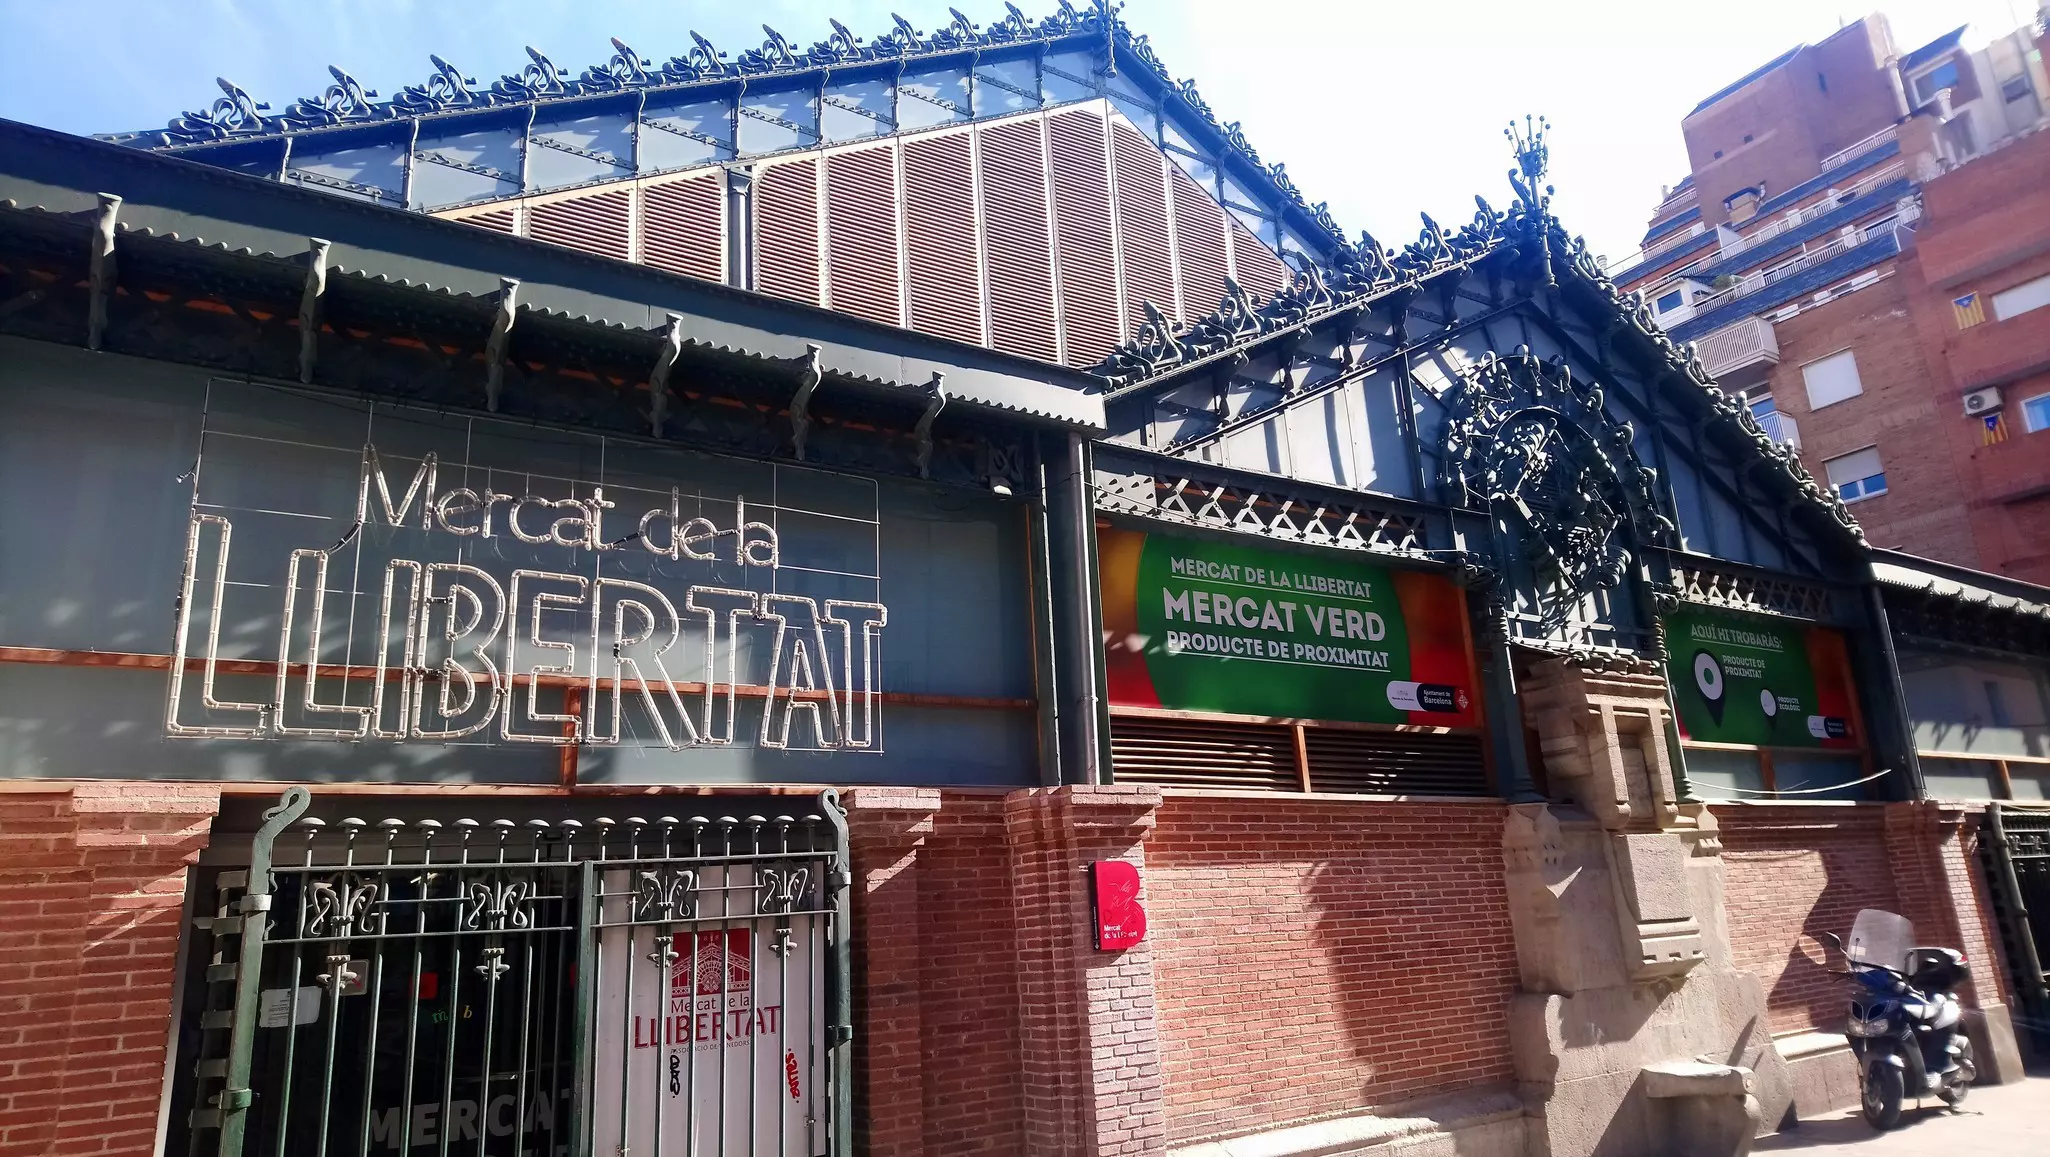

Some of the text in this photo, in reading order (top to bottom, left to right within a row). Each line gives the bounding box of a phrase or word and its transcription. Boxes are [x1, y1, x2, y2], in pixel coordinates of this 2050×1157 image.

[358, 442, 616, 551] Mercat
[1171, 557, 1372, 599] MERCAT DE LA LLIBERTAT
[1162, 587, 1386, 642] MERCAT VERD
[167, 513, 887, 752] LLIBERTAT
[1691, 623, 1717, 640] AQUÍ
[1718, 628, 1731, 641] HI
[1166, 630, 1390, 669] PRODUCTE DE PROXIMITAT
[1722, 655, 1766, 669] PRODUCTE DE
[1724, 666, 1762, 679] PROXIMITAT
[1424, 696, 1452, 705] Barcelona
[671, 998, 717, 1014] Mecat
[740, 993, 750, 1008] la
